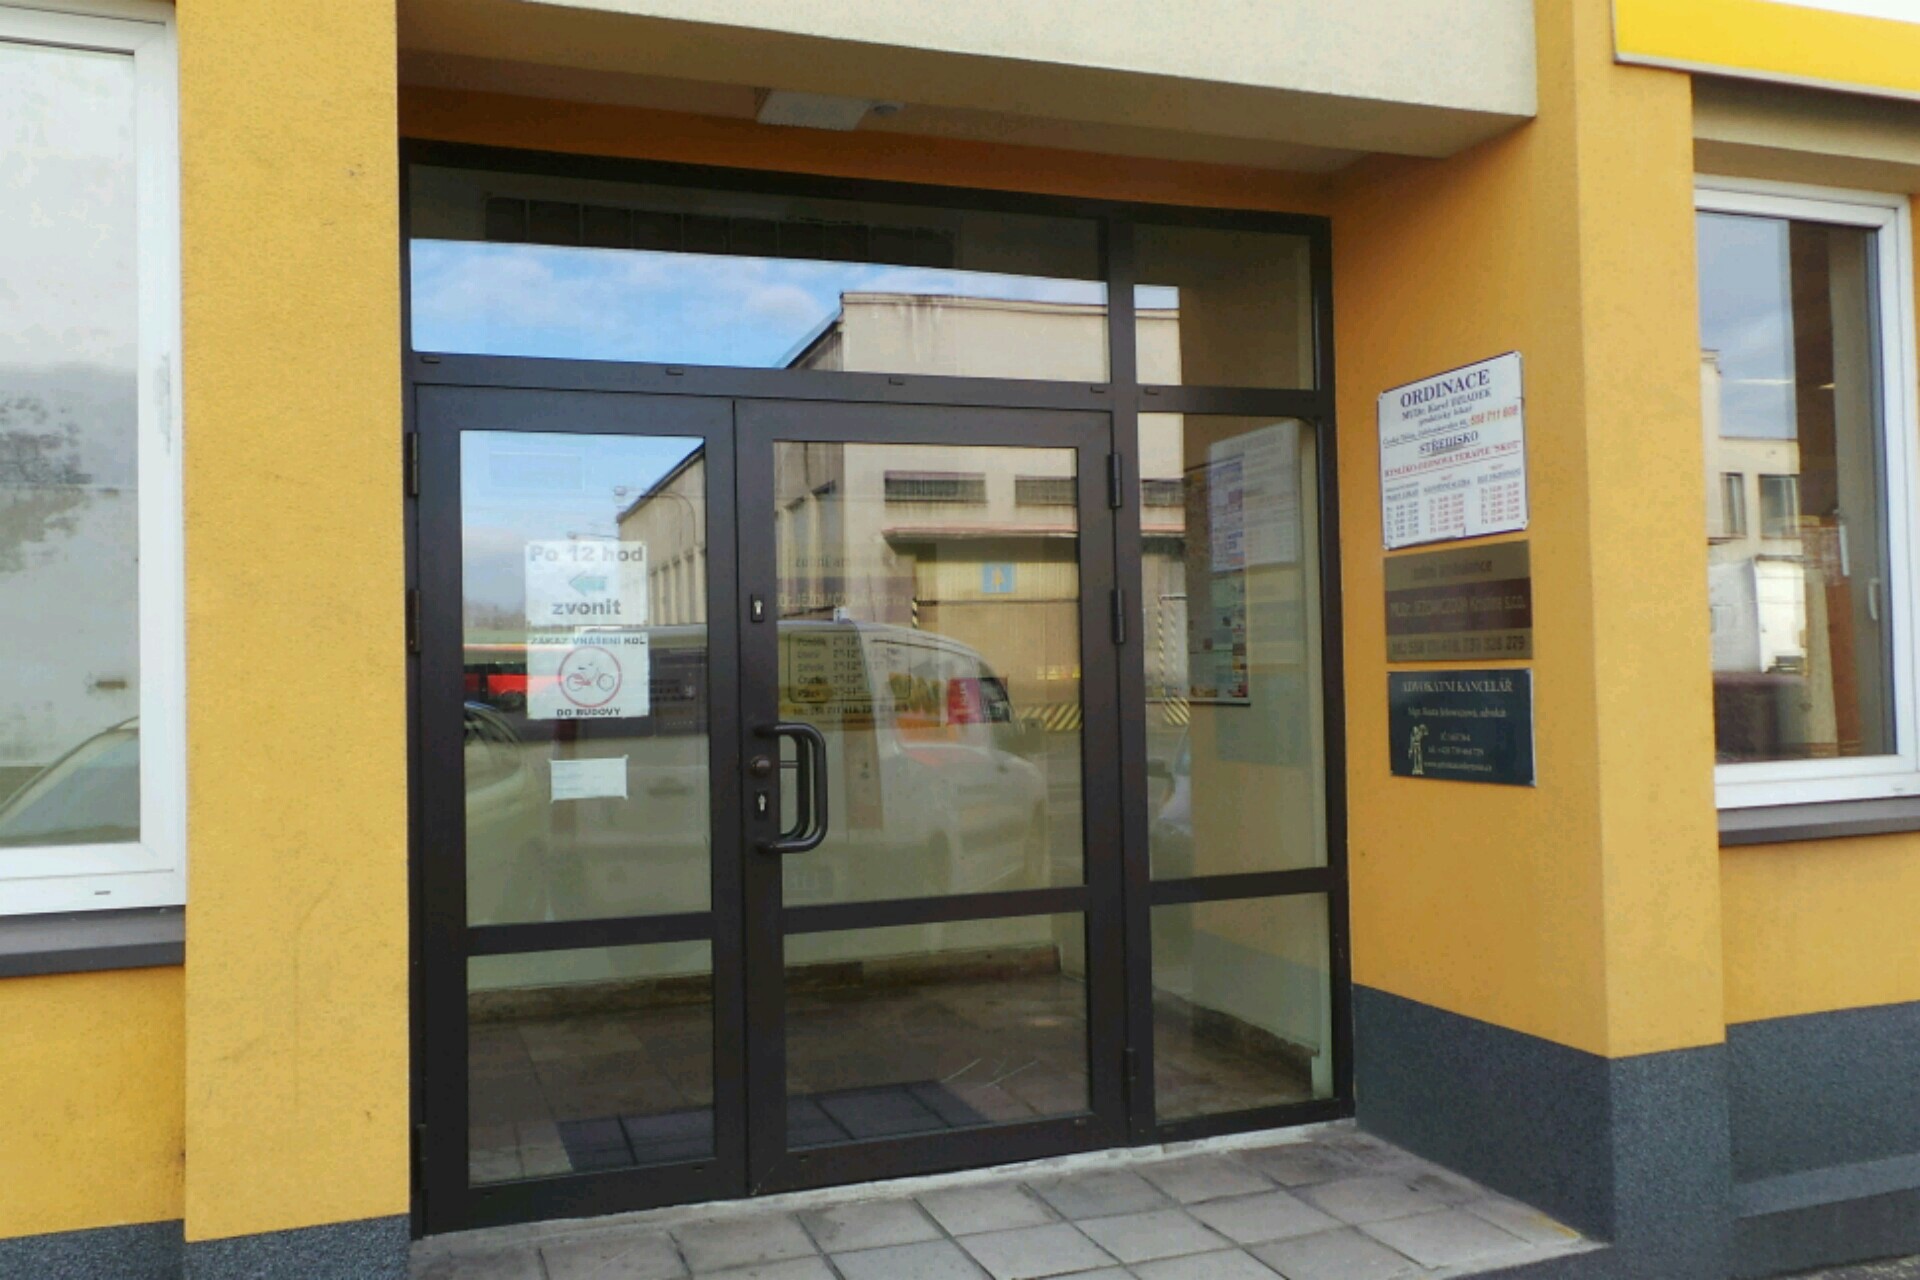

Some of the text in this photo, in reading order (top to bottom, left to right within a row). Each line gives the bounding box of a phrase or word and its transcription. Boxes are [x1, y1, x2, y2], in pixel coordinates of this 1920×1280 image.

[1400, 369, 1491, 408] ORDINACE
[1418, 430, 1480, 454] STŘEDISKO
[530, 545, 644, 562] Po 12 hod
[552, 599, 622, 615] zvonit
[1457, 677, 1514, 693] KANCELÁŘ
[556, 708, 621, 717] DO BUDOVY
